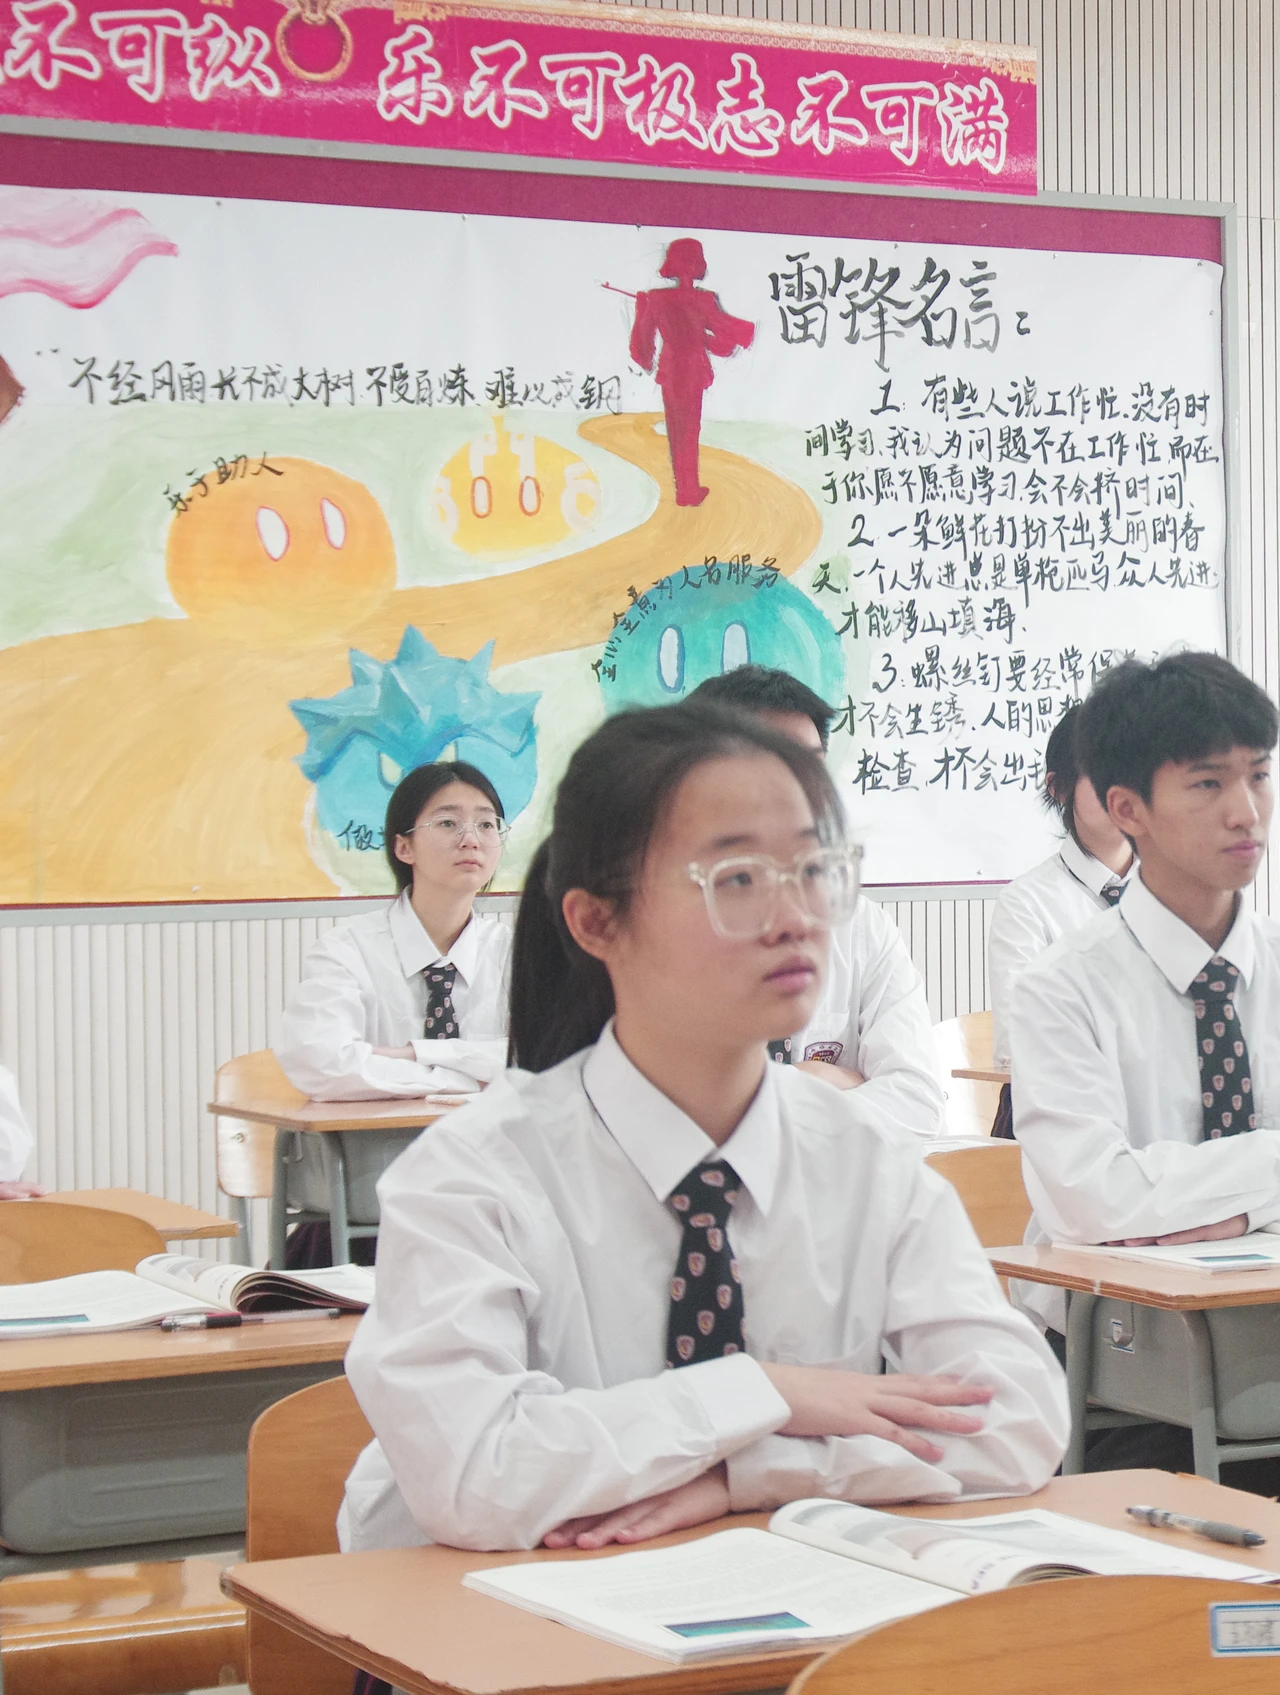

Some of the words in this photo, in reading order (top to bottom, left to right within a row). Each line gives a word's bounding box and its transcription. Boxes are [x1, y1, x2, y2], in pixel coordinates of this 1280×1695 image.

[0, 0, 280, 102] 不可纵
[336, 820, 385, 852] 做
